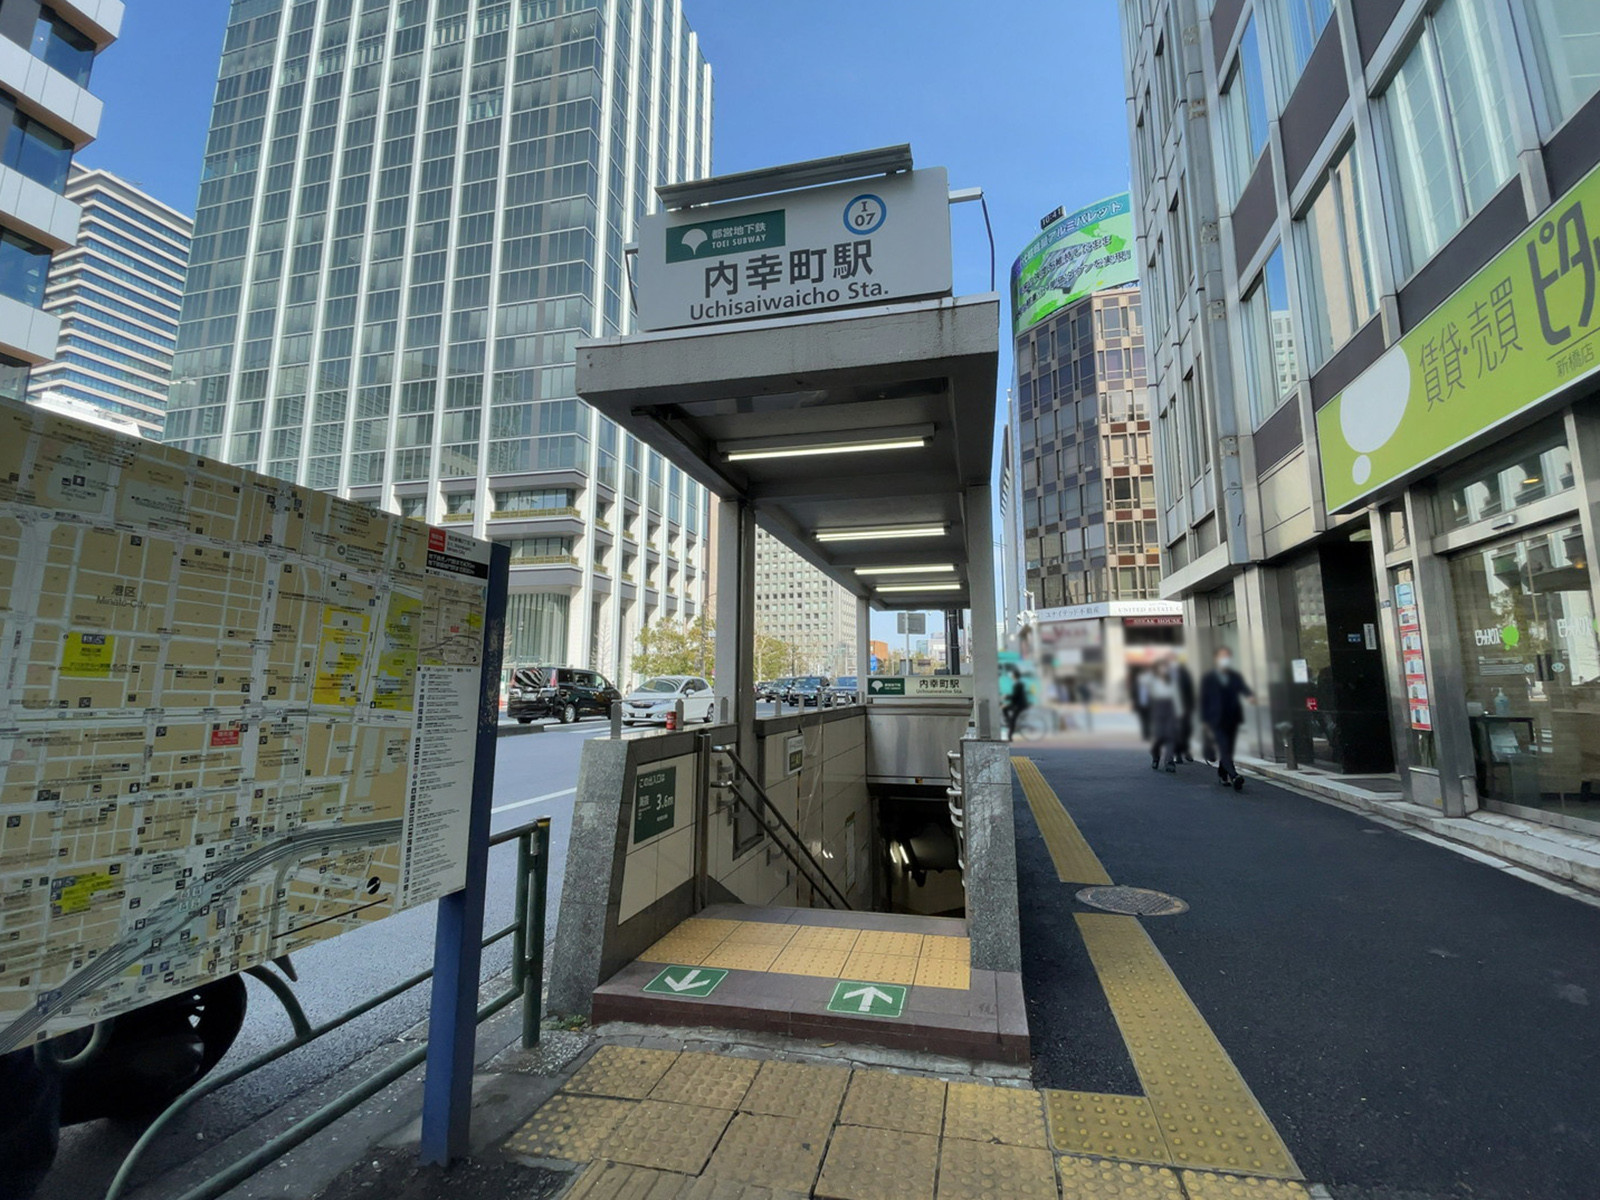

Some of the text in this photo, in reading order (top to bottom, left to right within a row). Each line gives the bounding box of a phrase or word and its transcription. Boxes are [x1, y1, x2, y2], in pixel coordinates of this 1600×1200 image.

[711, 221, 767, 240] 都営地下鉄
[854, 211, 876, 227] 07
[711, 233, 767, 249] TOEI SUBWAY
[704, 239, 874, 298] 内幸町駅
[1526, 200, 1600, 346] ピタ
[689, 280, 889, 321] Uchisaiwaicho Sta.
[1555, 342, 1595, 378] 新橋店
